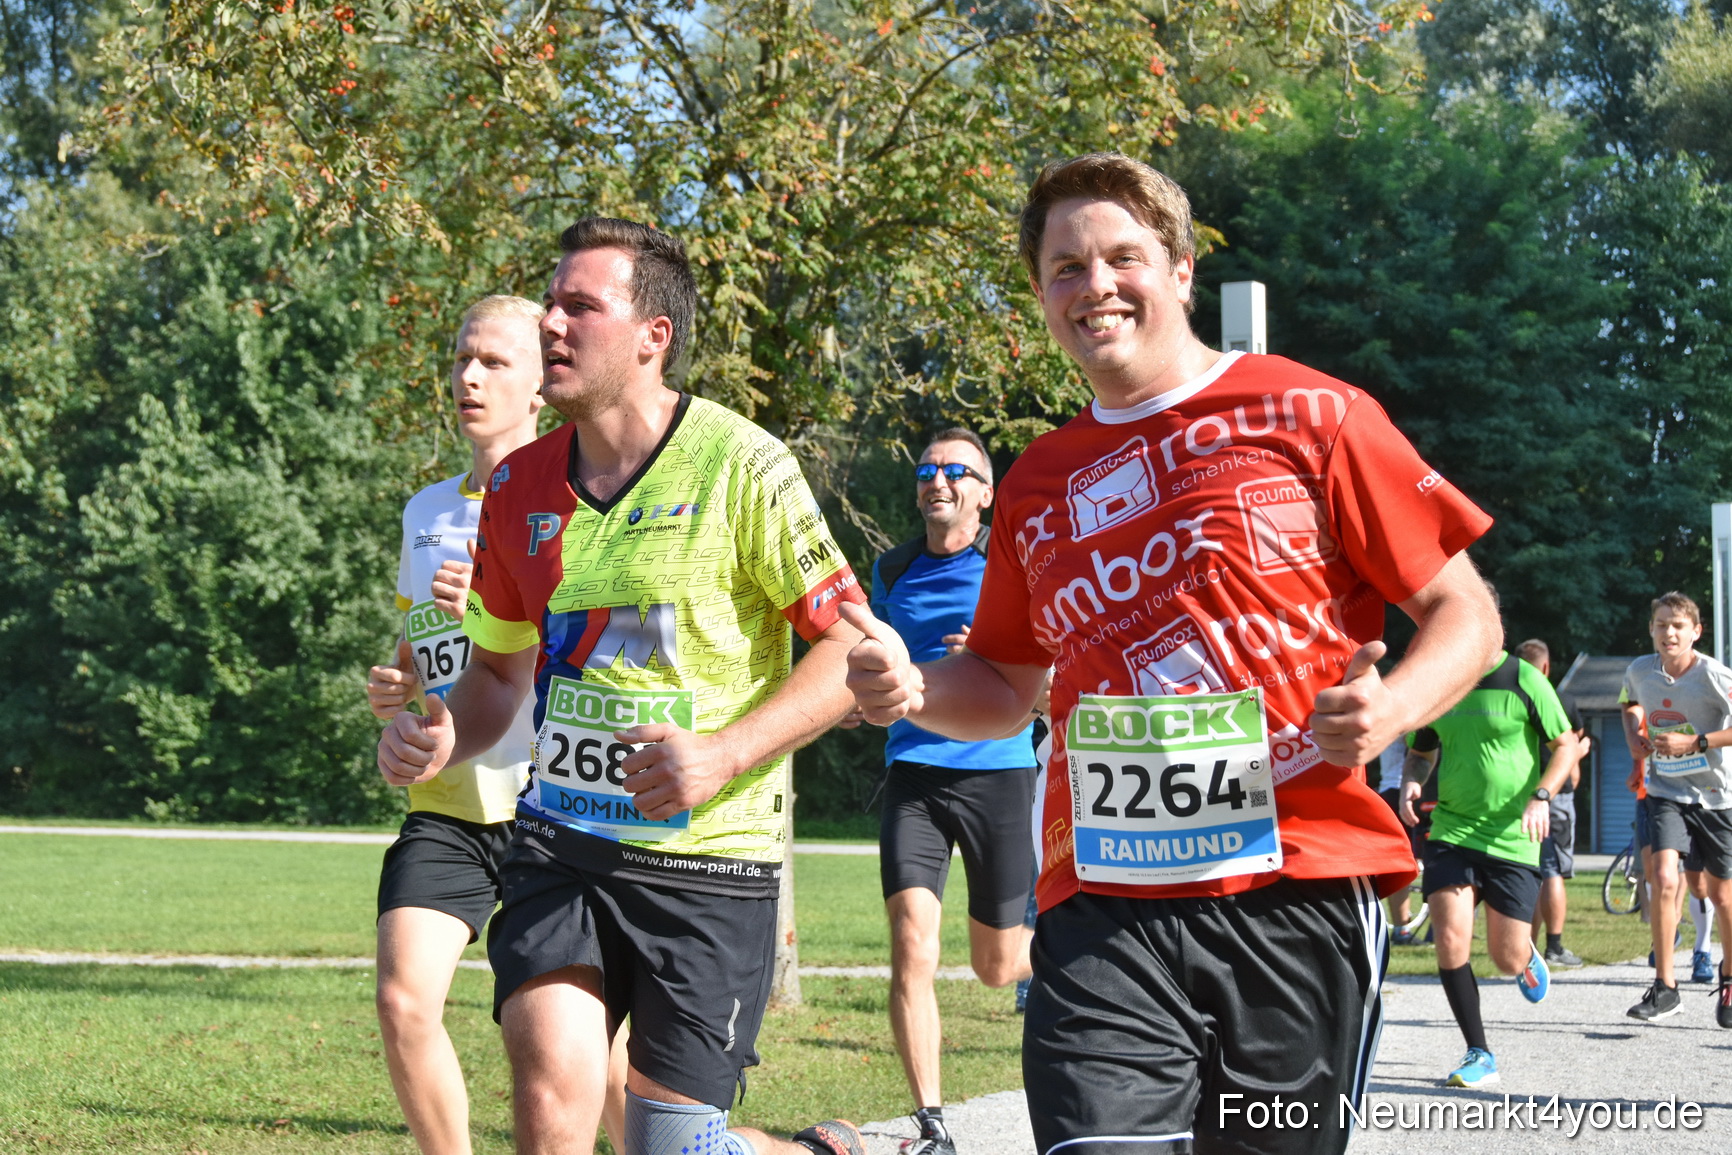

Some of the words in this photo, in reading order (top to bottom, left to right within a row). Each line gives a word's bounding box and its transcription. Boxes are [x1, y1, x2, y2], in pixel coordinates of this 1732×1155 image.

[1160, 388, 1357, 472] raum
[1171, 449, 1274, 495] schenken
[644, 524, 681, 533] NEUMARKT
[1015, 503, 1055, 567] ox
[1034, 508, 1224, 654] umbox
[1152, 565, 1229, 609] outdoor
[1130, 623, 1197, 669] raumbox
[553, 685, 679, 726] BOCK
[1077, 701, 1245, 744] BOCK
[548, 732, 657, 787] 268
[1250, 761, 1259, 770] C
[1283, 752, 1320, 776] outdoor
[560, 790, 669, 824] DOMIN
[1087, 760, 1247, 818] 2264
[622, 850, 761, 878] www.bmw-partl.de
[1100, 831, 1244, 862] RAIMUND
